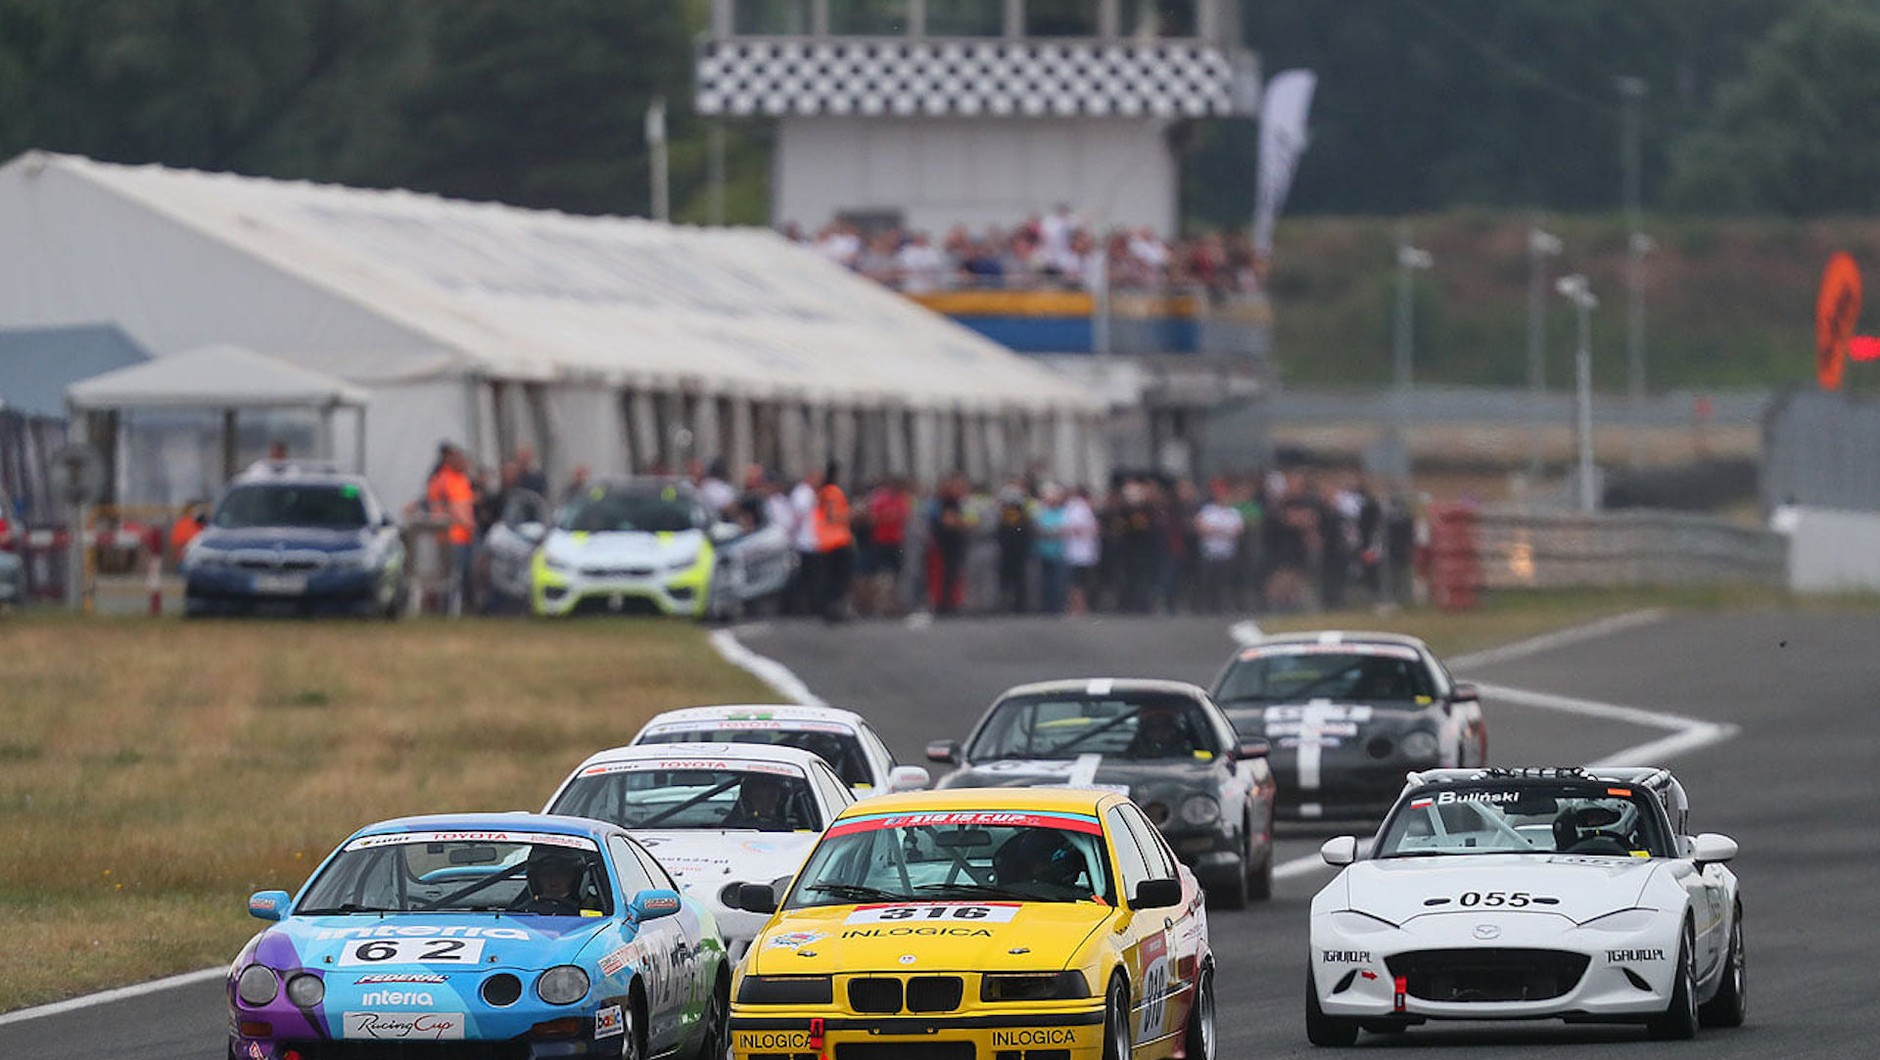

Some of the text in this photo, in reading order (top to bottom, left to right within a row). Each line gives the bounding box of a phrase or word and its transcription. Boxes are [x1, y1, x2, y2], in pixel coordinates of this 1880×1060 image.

[658, 761, 728, 769] TOYOTA
[432, 833, 508, 841] TOYOTA
[1459, 892, 1531, 907] 055
[879, 906, 991, 920] 316
[315, 924, 531, 941] interia
[841, 927, 993, 939] INLOGICA
[355, 940, 466, 962] 62
[357, 973, 448, 984] FEDERAL
[362, 989, 434, 1007] interia
[992, 1030, 1076, 1047] INLOGICA
